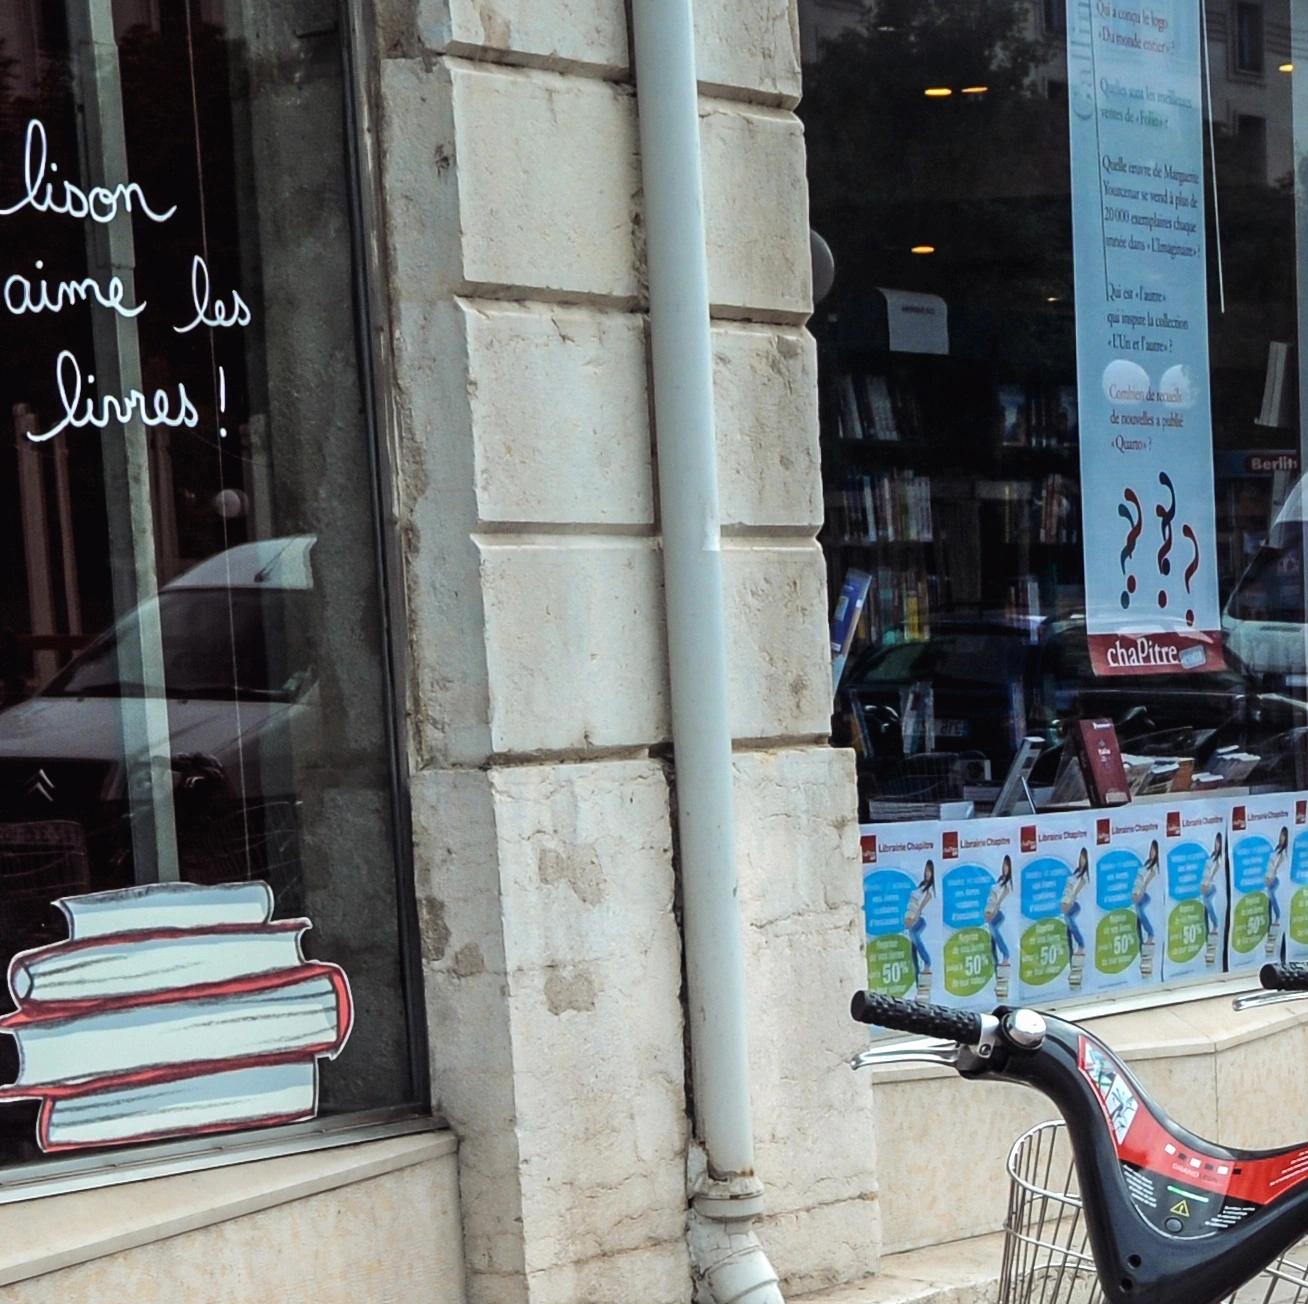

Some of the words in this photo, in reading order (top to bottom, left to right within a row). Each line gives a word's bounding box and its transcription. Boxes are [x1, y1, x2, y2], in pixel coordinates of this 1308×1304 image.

[4, 260, 146, 316] aime
[173, 255, 252, 333] les
[27, 350, 199, 442] livres
[1110, 408, 1120, 425] de
[1121, 410, 1154, 426] nouvelles
[879, 842, 906, 852] Librairie
[907, 841, 934, 851] Chapitre
[960, 839, 985, 849] Librairie
[986, 837, 1010, 847] Chapitre
